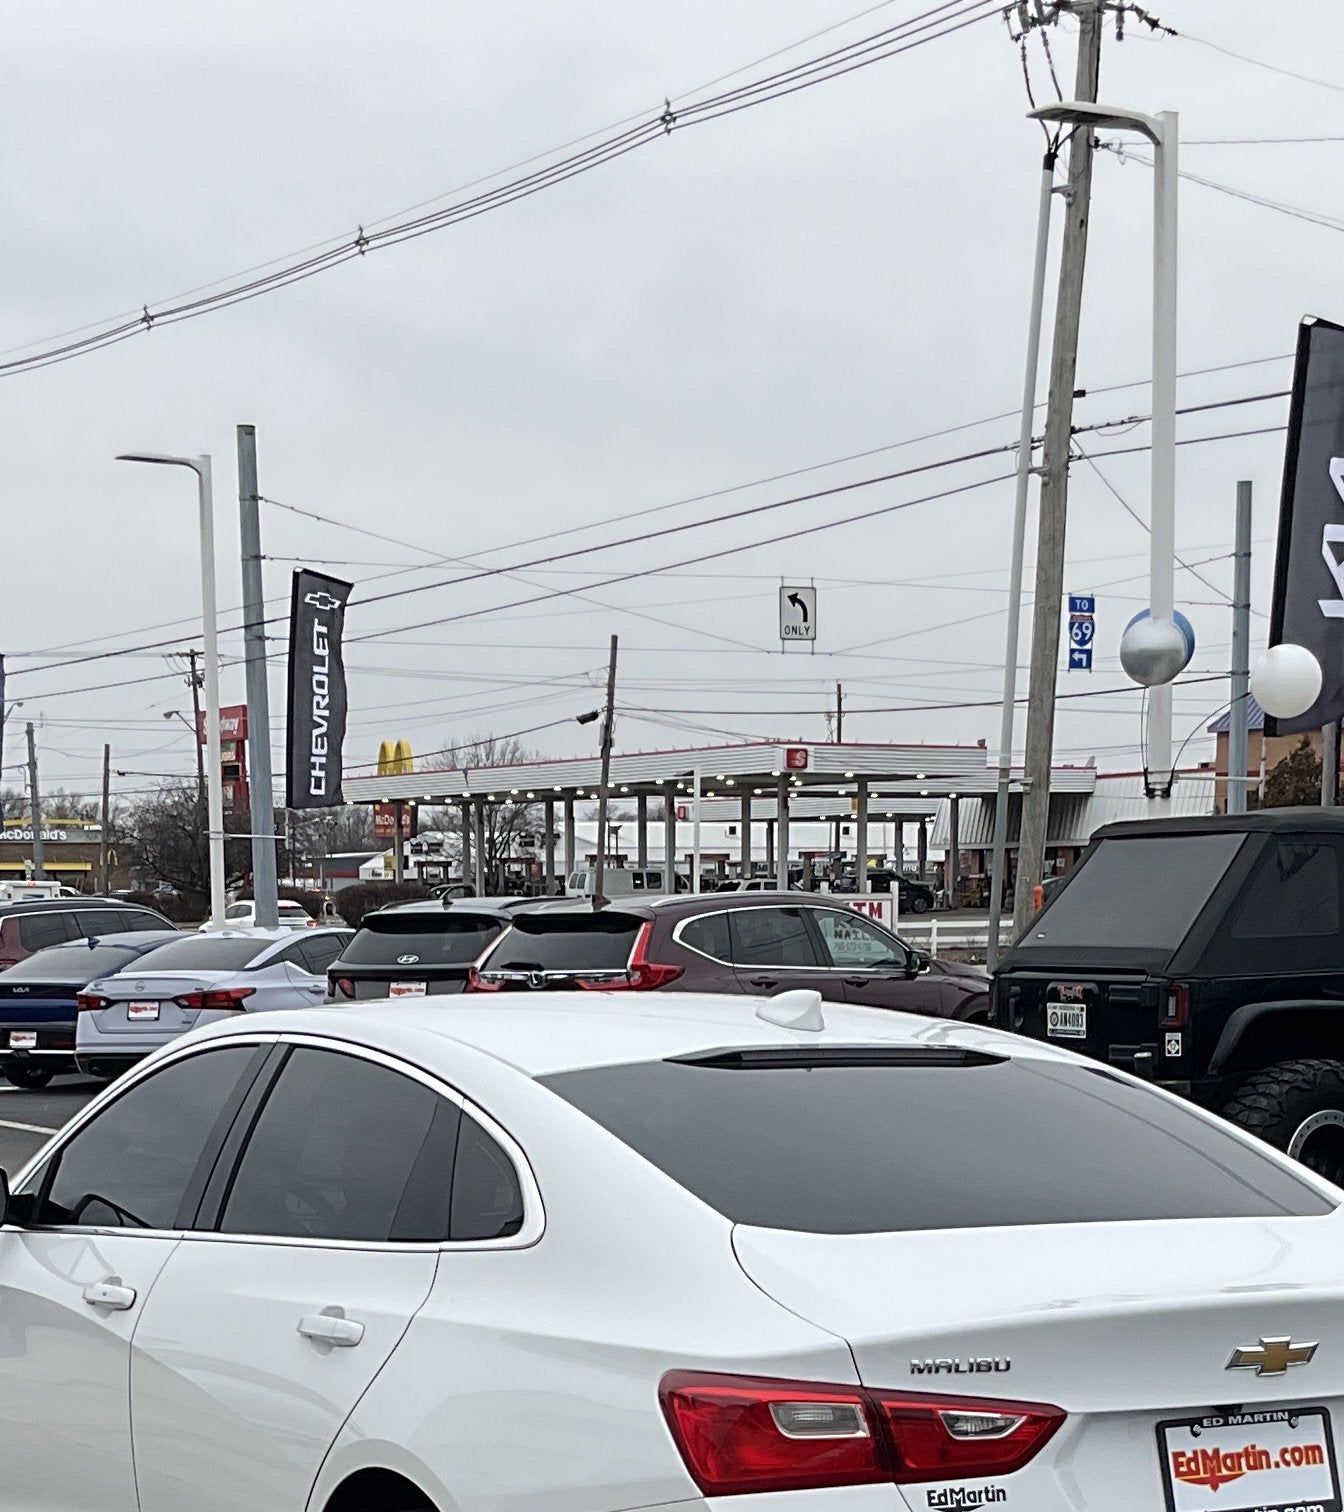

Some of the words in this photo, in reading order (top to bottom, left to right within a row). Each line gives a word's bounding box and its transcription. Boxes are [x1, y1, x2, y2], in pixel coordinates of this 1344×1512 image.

[1076, 600, 1088, 610] TO
[784, 625, 810, 636] ONLY
[1072, 623, 1092, 640] 69
[310, 618, 330, 796] CHEVROLET
[851, 902, 883, 919] TM
[910, 1358, 1011, 1375] MALIBU
[1202, 1416, 1224, 1428] ED
[1228, 1411, 1289, 1426] MARTIN
[926, 1485, 1007, 1507] EdMartin
